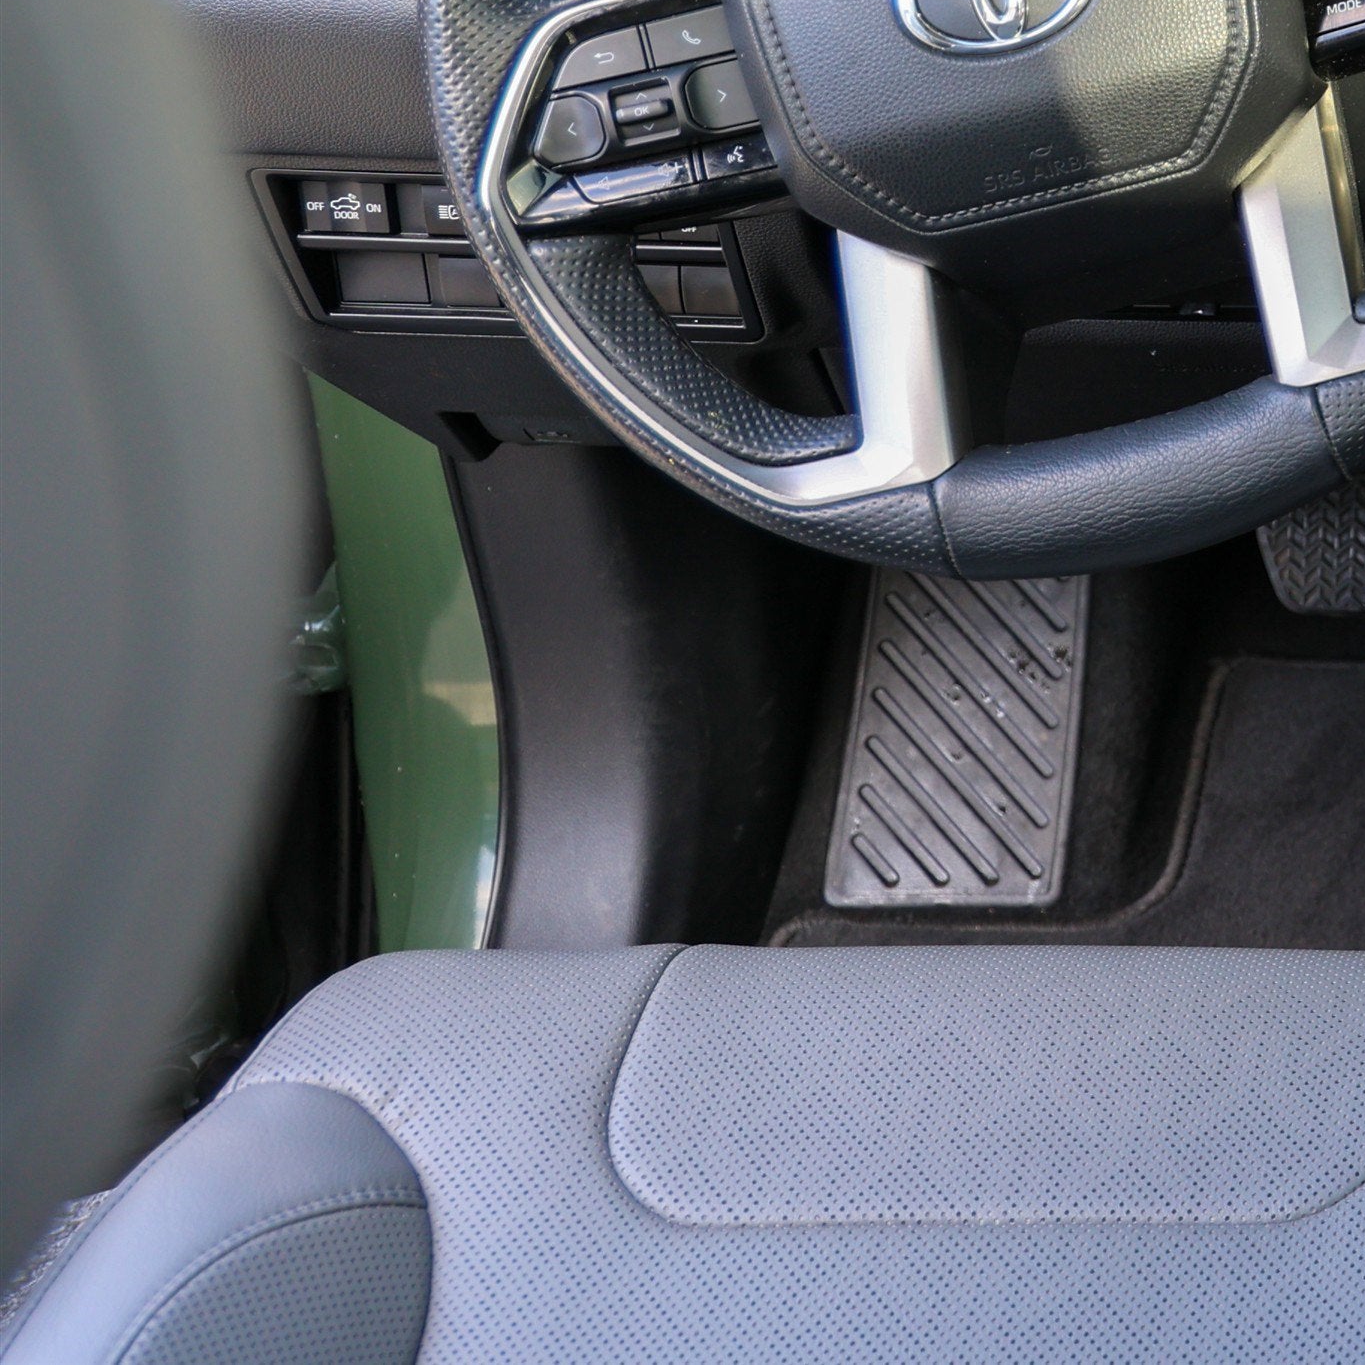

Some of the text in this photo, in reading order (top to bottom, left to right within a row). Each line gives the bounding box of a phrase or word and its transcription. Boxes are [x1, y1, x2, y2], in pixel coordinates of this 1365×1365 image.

[634, 107, 649, 117] OK
[307, 201, 324, 211] OFF
[366, 203, 382, 213] ON
[334, 211, 359, 220] DOOR
